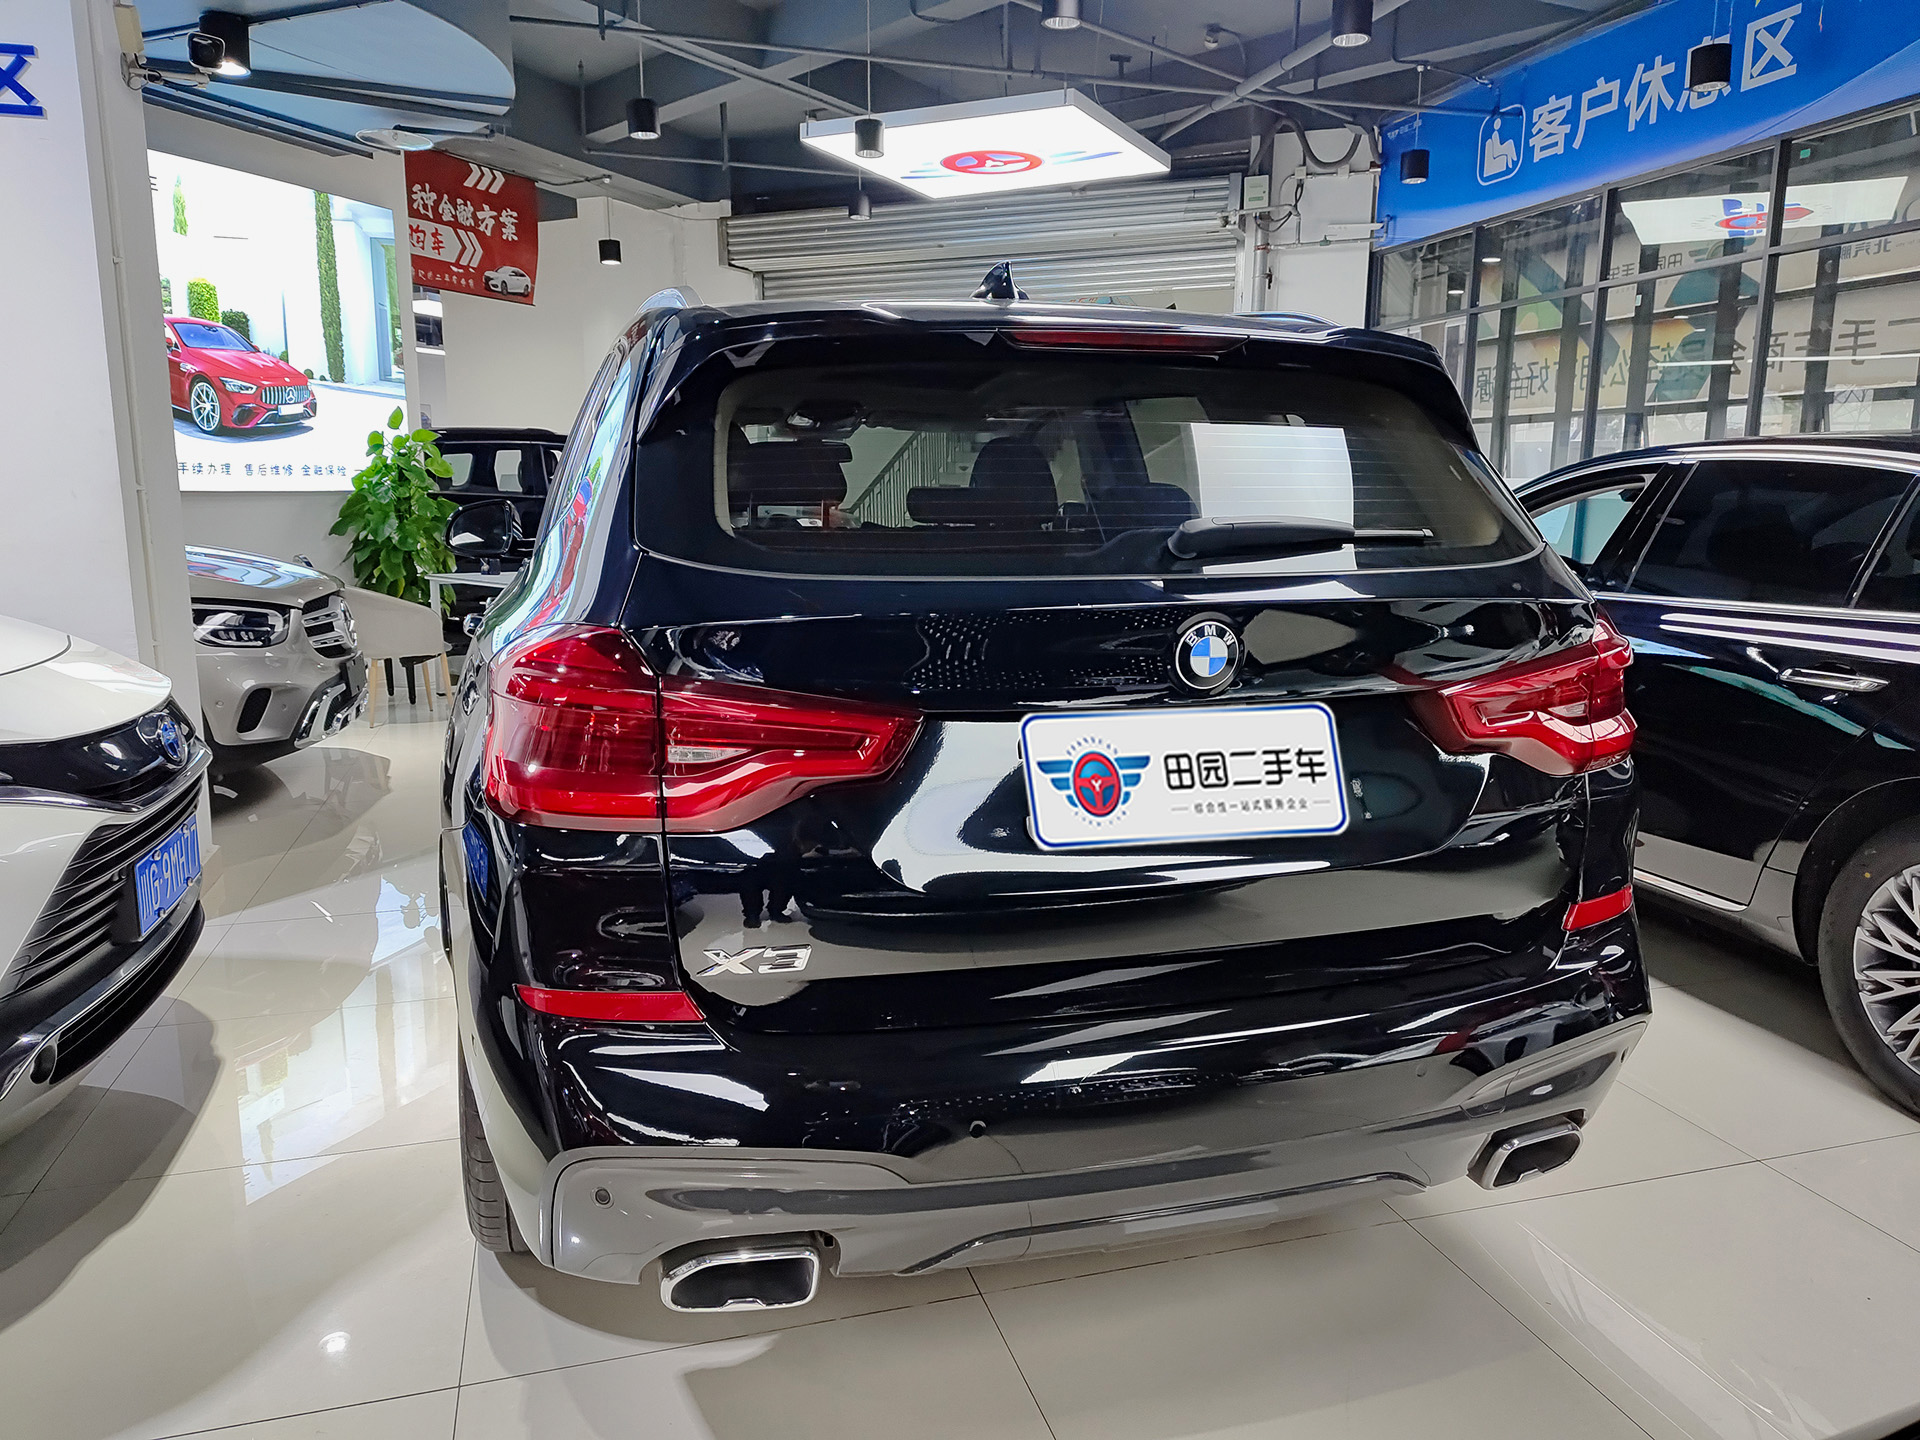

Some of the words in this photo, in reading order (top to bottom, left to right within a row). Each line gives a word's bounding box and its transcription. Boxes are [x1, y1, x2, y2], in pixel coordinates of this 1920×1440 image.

[411, 182, 519, 242] 种金融方案
[177, 461, 232, 476] 手续办理
[244, 463, 293, 477] 售后维修
[301, 463, 347, 477] 金融保险
[1185, 624, 1235, 647] BMW
[696, 945, 812, 976] X3
